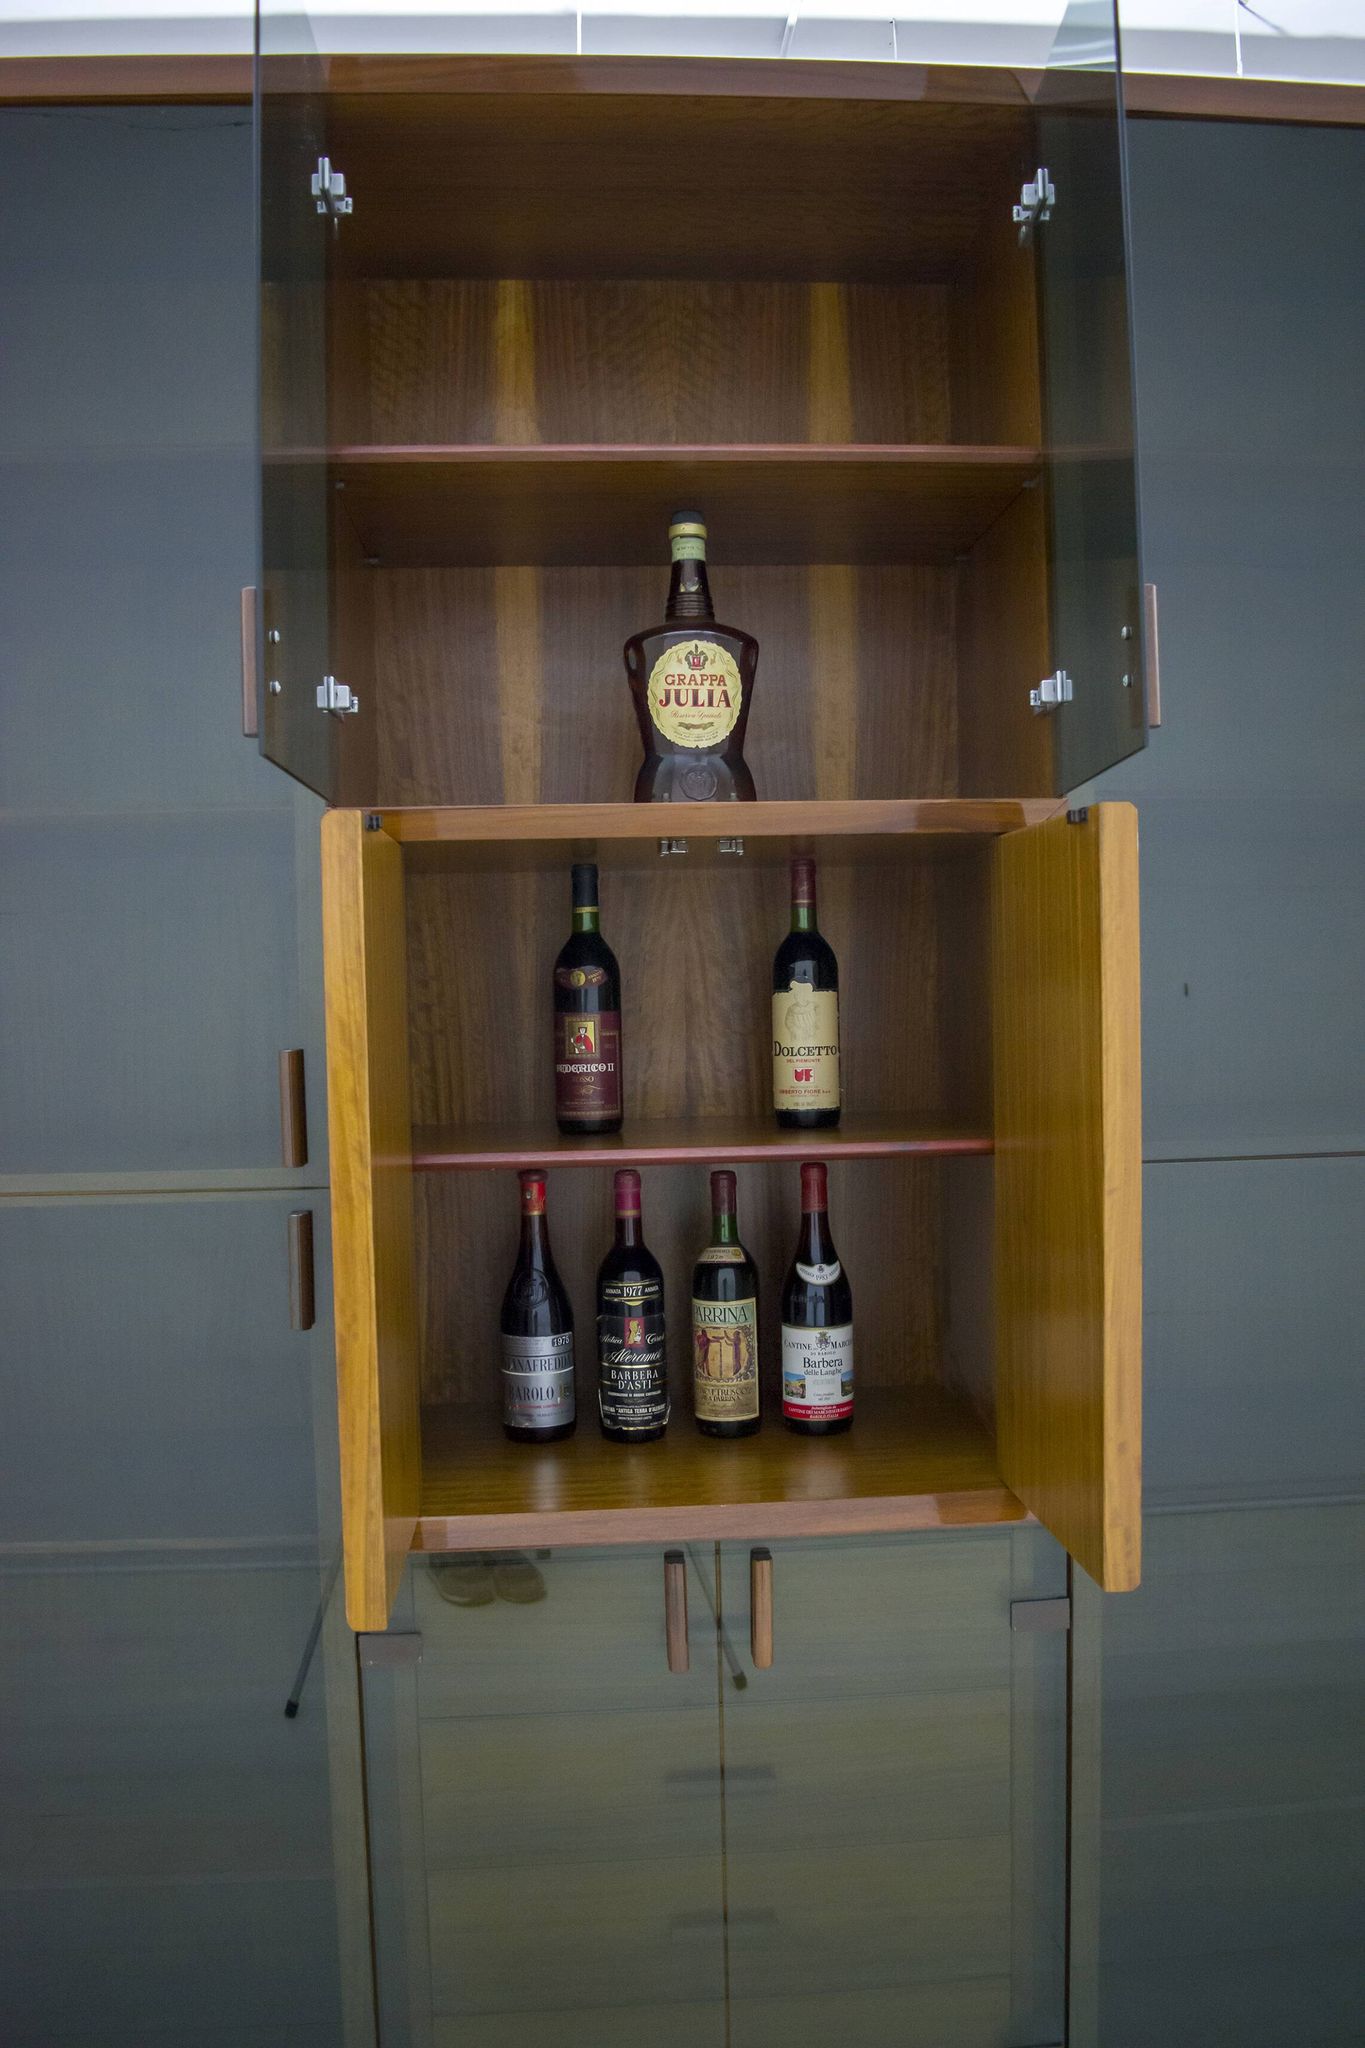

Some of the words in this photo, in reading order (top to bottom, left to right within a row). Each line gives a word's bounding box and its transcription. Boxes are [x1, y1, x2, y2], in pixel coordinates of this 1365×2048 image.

[664, 673, 727, 686] GRAPPA
[658, 688, 732, 708] JULIA
[774, 1041, 838, 1057] DOLCETTO
[607, 1062, 615, 1072] II
[623, 1286, 643, 1297] 1977
[783, 1339, 813, 1351] CANTINE
[803, 1356, 843, 1369] Barbera
[611, 1369, 658, 1381] BARBERA
[820, 1367, 843, 1377] Langhe
[618, 1380, 652, 1391] D'ASTI
